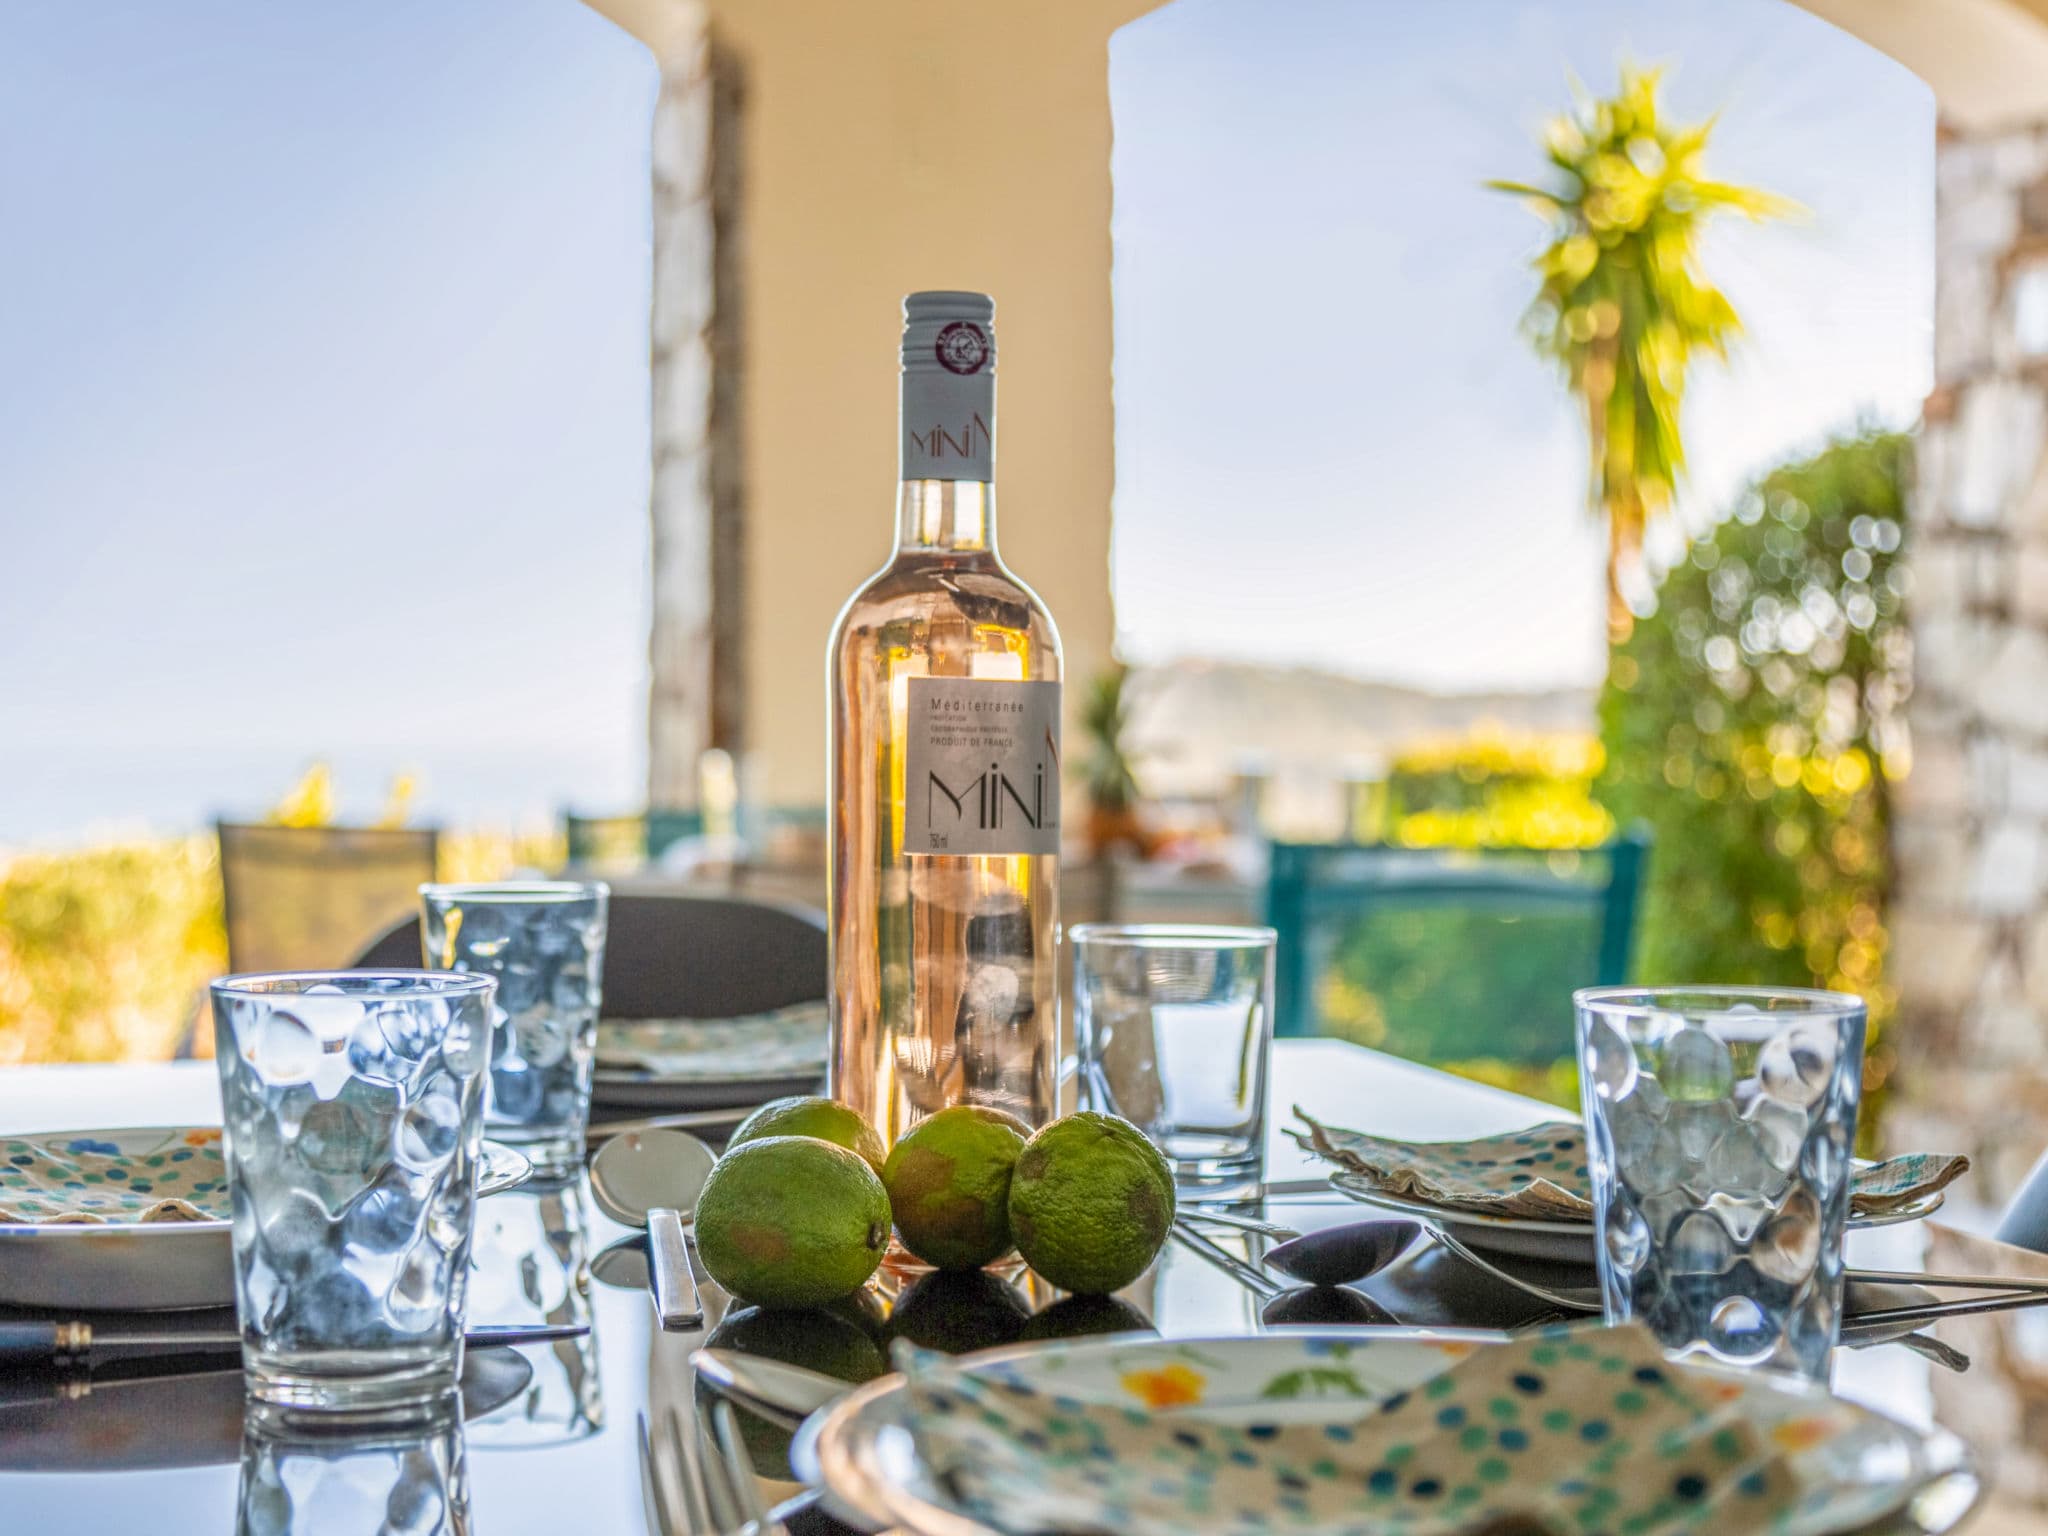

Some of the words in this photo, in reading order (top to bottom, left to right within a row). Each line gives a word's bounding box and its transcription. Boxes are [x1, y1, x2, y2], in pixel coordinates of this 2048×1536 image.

[930, 736, 967, 747] PRODUIT
[970, 737, 981, 748] DE
[983, 737, 1013, 748] FRANCE
